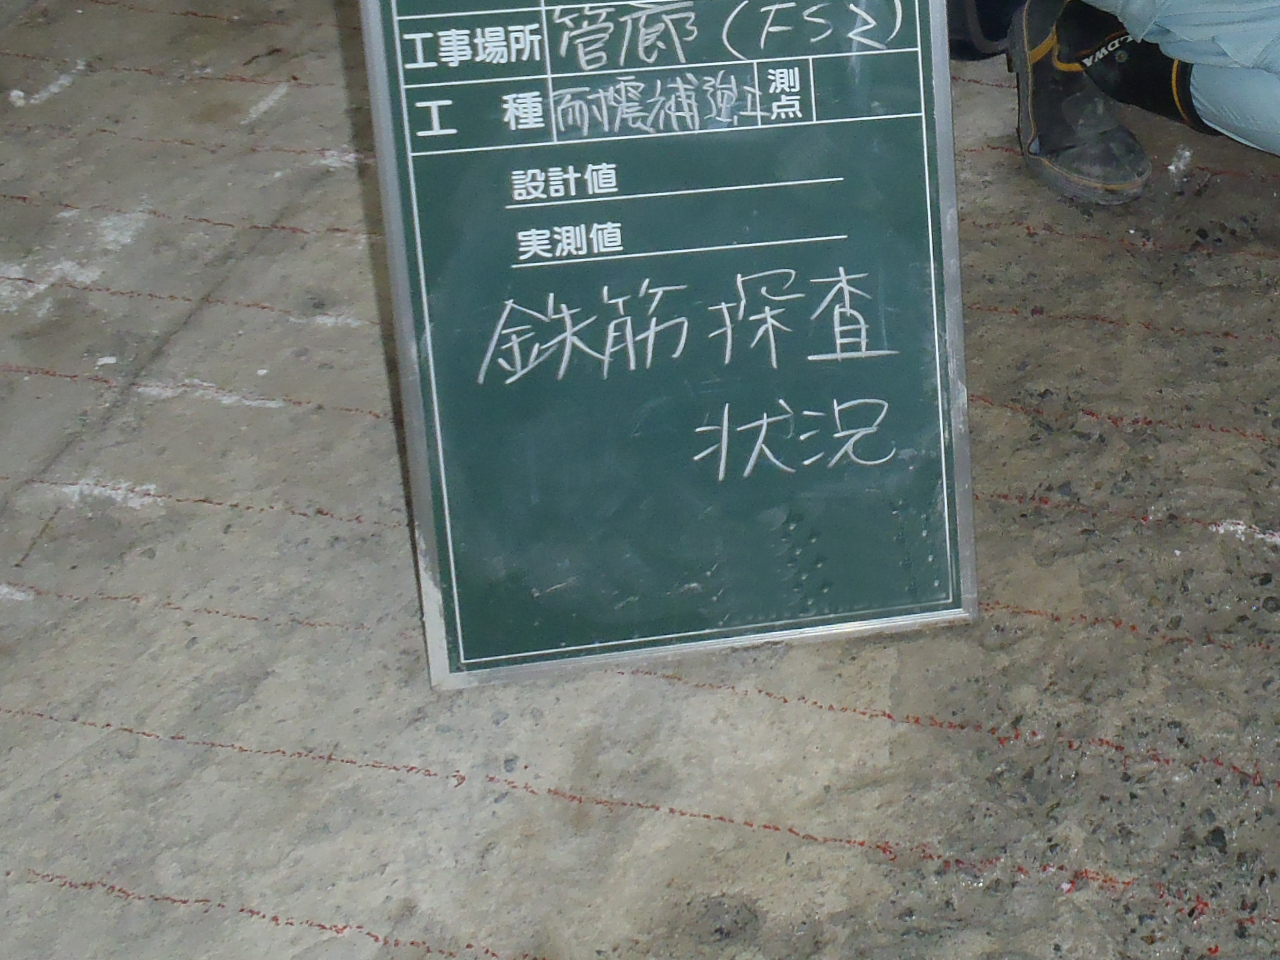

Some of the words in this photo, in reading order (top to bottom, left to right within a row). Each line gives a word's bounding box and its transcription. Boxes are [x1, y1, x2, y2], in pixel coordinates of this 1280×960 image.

[403, 23, 543, 71] 工事場所
[511, 163, 618, 201] 設計値
[516, 221, 624, 260] 実測値
[477, 265, 900, 385] 鉄筋探査
[693, 397, 898, 482] 状況
